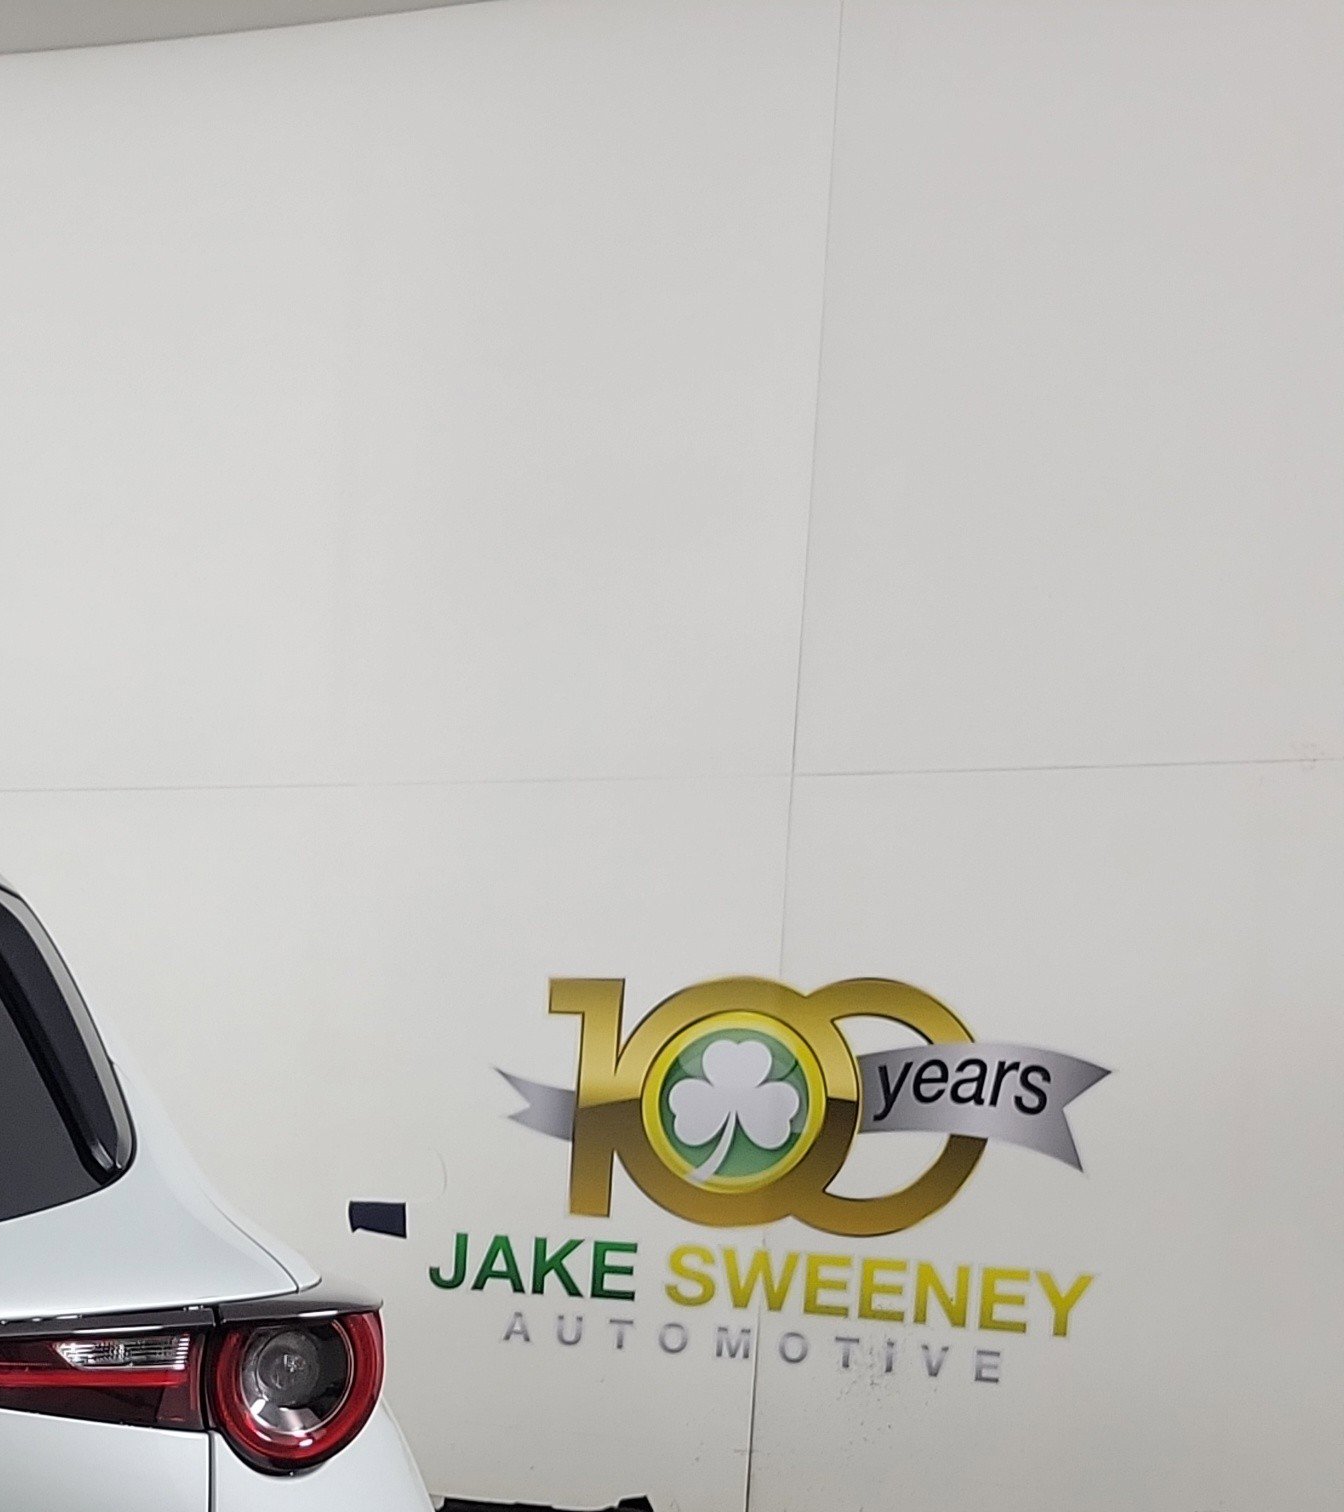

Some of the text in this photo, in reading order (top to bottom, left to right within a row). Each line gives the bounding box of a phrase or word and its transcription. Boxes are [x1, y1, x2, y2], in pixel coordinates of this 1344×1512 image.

[872, 1054, 1052, 1121] years
[429, 1232, 1095, 1338] JAKE SWEENEY
[502, 1310, 1004, 1386] AUTOMOTIVE
